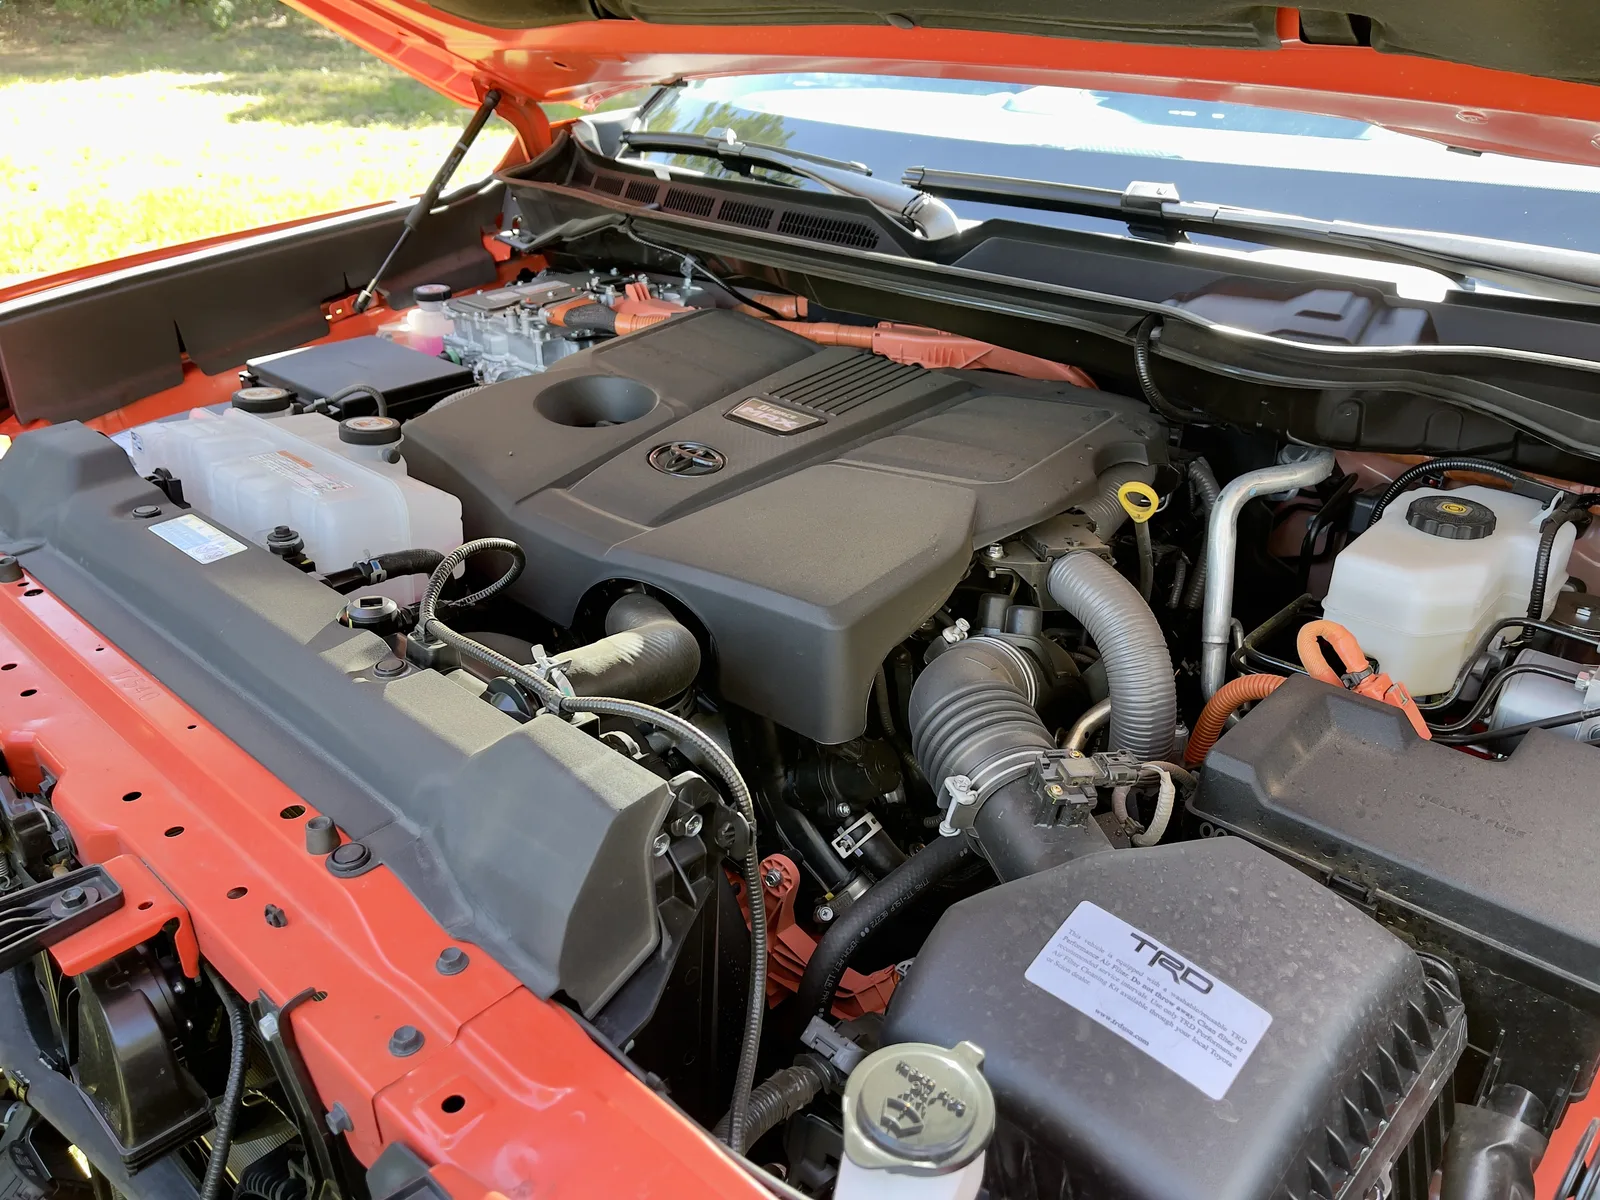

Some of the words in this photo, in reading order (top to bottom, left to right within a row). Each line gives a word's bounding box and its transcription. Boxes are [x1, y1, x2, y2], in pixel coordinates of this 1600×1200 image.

[1051, 948, 1063, 958] Air
[1062, 955, 1080, 968] Filter
[1079, 964, 1109, 985] Cleaning
[1108, 982, 1121, 993] Kit
[1119, 989, 1149, 1010] available
[1148, 1007, 1175, 1027] through
[1173, 1025, 1191, 1039] your
[1191, 1036, 1209, 1051] local
[1208, 1047, 1234, 1068] Toyota
[1053, 959, 1072, 973] Scion
[1070, 969, 1092, 986] dealer.
[1056, 942, 1098, 969] recommended
[1097, 966, 1121, 982] service
[1119, 979, 1149, 1001] intervals.
[1149, 998, 1163, 1009] Use
[1161, 1006, 1178, 1020] only
[1177, 1016, 1196, 1031] TRD
[1195, 1028, 1239, 1060] Performance
[1062, 935, 1100, 960] Performance
[1099, 957, 1111, 967] Air
[1110, 964, 1131, 979] Filter.
[1129, 975, 1142, 986] Do
[1141, 983, 1154, 993] not
[1154, 991, 1175, 1007] throw
[1174, 1005, 1197, 1022] away.
[1196, 1018, 1217, 1035] Clean
[1216, 1032, 1236, 1047] filter
[1067, 928, 1082, 939] This
[1083, 938, 1105, 953] vehicle
[1114, 957, 1144, 977] equipped
[1145, 975, 1161, 988] with
[1169, 991, 1228, 1032] washable/reusable
[1229, 1030, 1248, 1045] TRD
[1130, 931, 1214, 995] TRD
